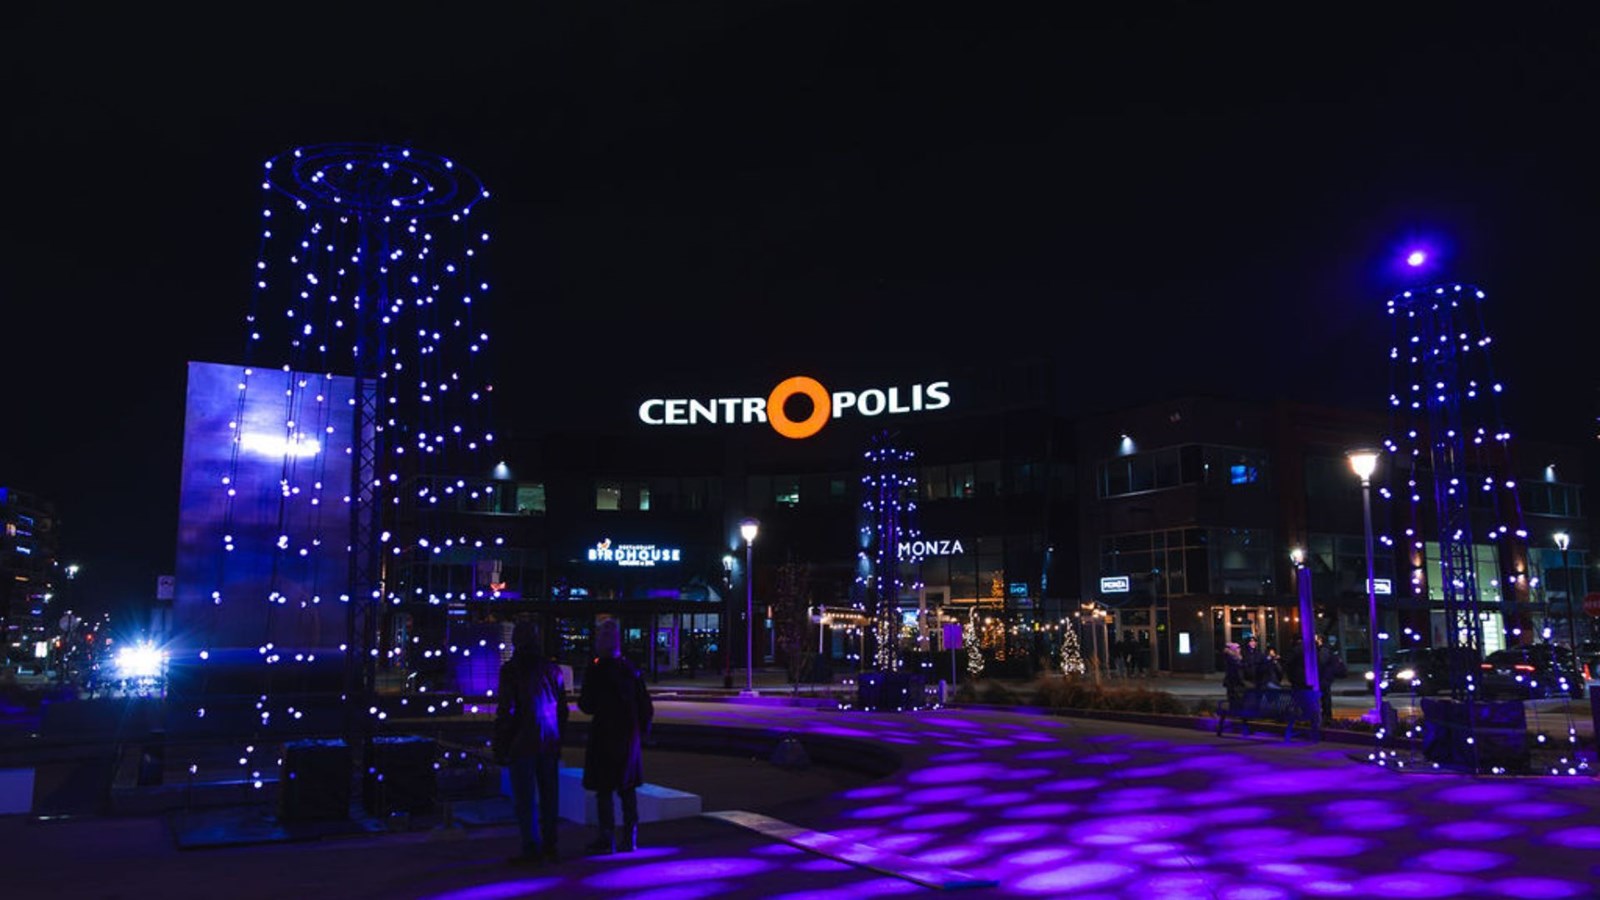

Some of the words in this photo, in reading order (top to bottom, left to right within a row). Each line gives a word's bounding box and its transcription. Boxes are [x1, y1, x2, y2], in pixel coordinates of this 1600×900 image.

[638, 376, 951, 439] CENTROPOLIS
[588, 548, 681, 561] BIRDHOUSE
[897, 539, 964, 557] MONZA
